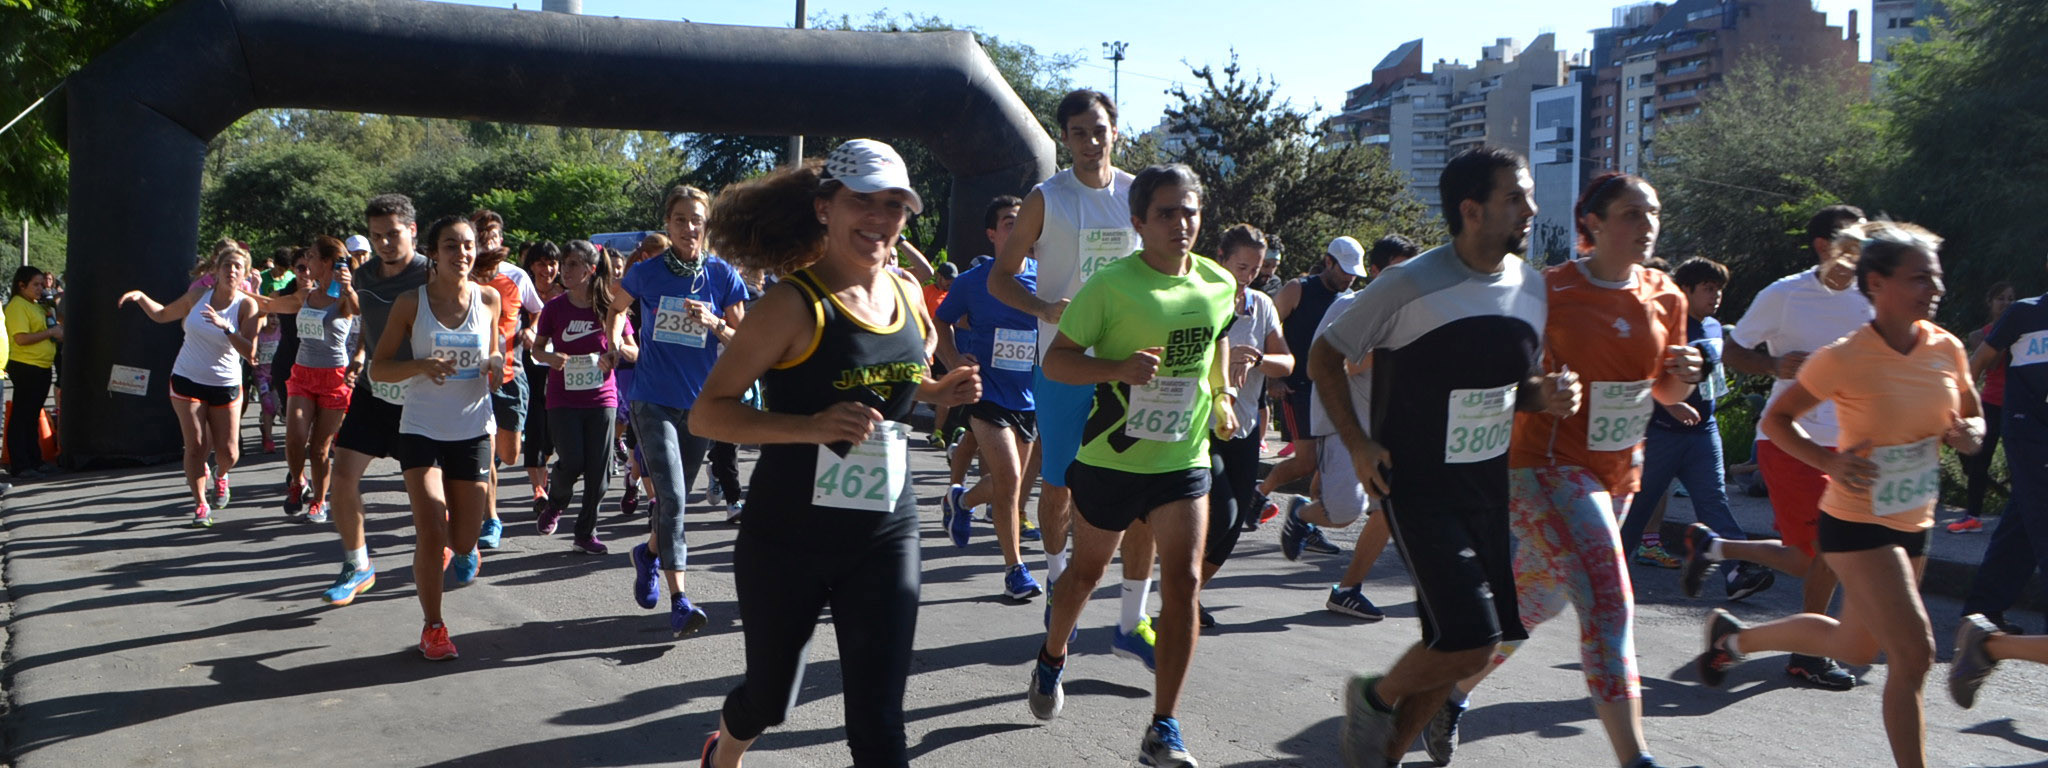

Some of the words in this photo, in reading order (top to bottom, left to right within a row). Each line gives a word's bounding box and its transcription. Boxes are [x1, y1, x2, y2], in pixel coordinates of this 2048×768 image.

[1082, 256, 1119, 277] 46
[299, 322, 323, 336] 4636
[567, 320, 594, 333] NIKE
[1172, 326, 1214, 346] BIEN
[994, 342, 1035, 360] 2362
[566, 369, 602, 386] 3834
[1129, 408, 1193, 434] 4625
[1449, 419, 1511, 453] 3806
